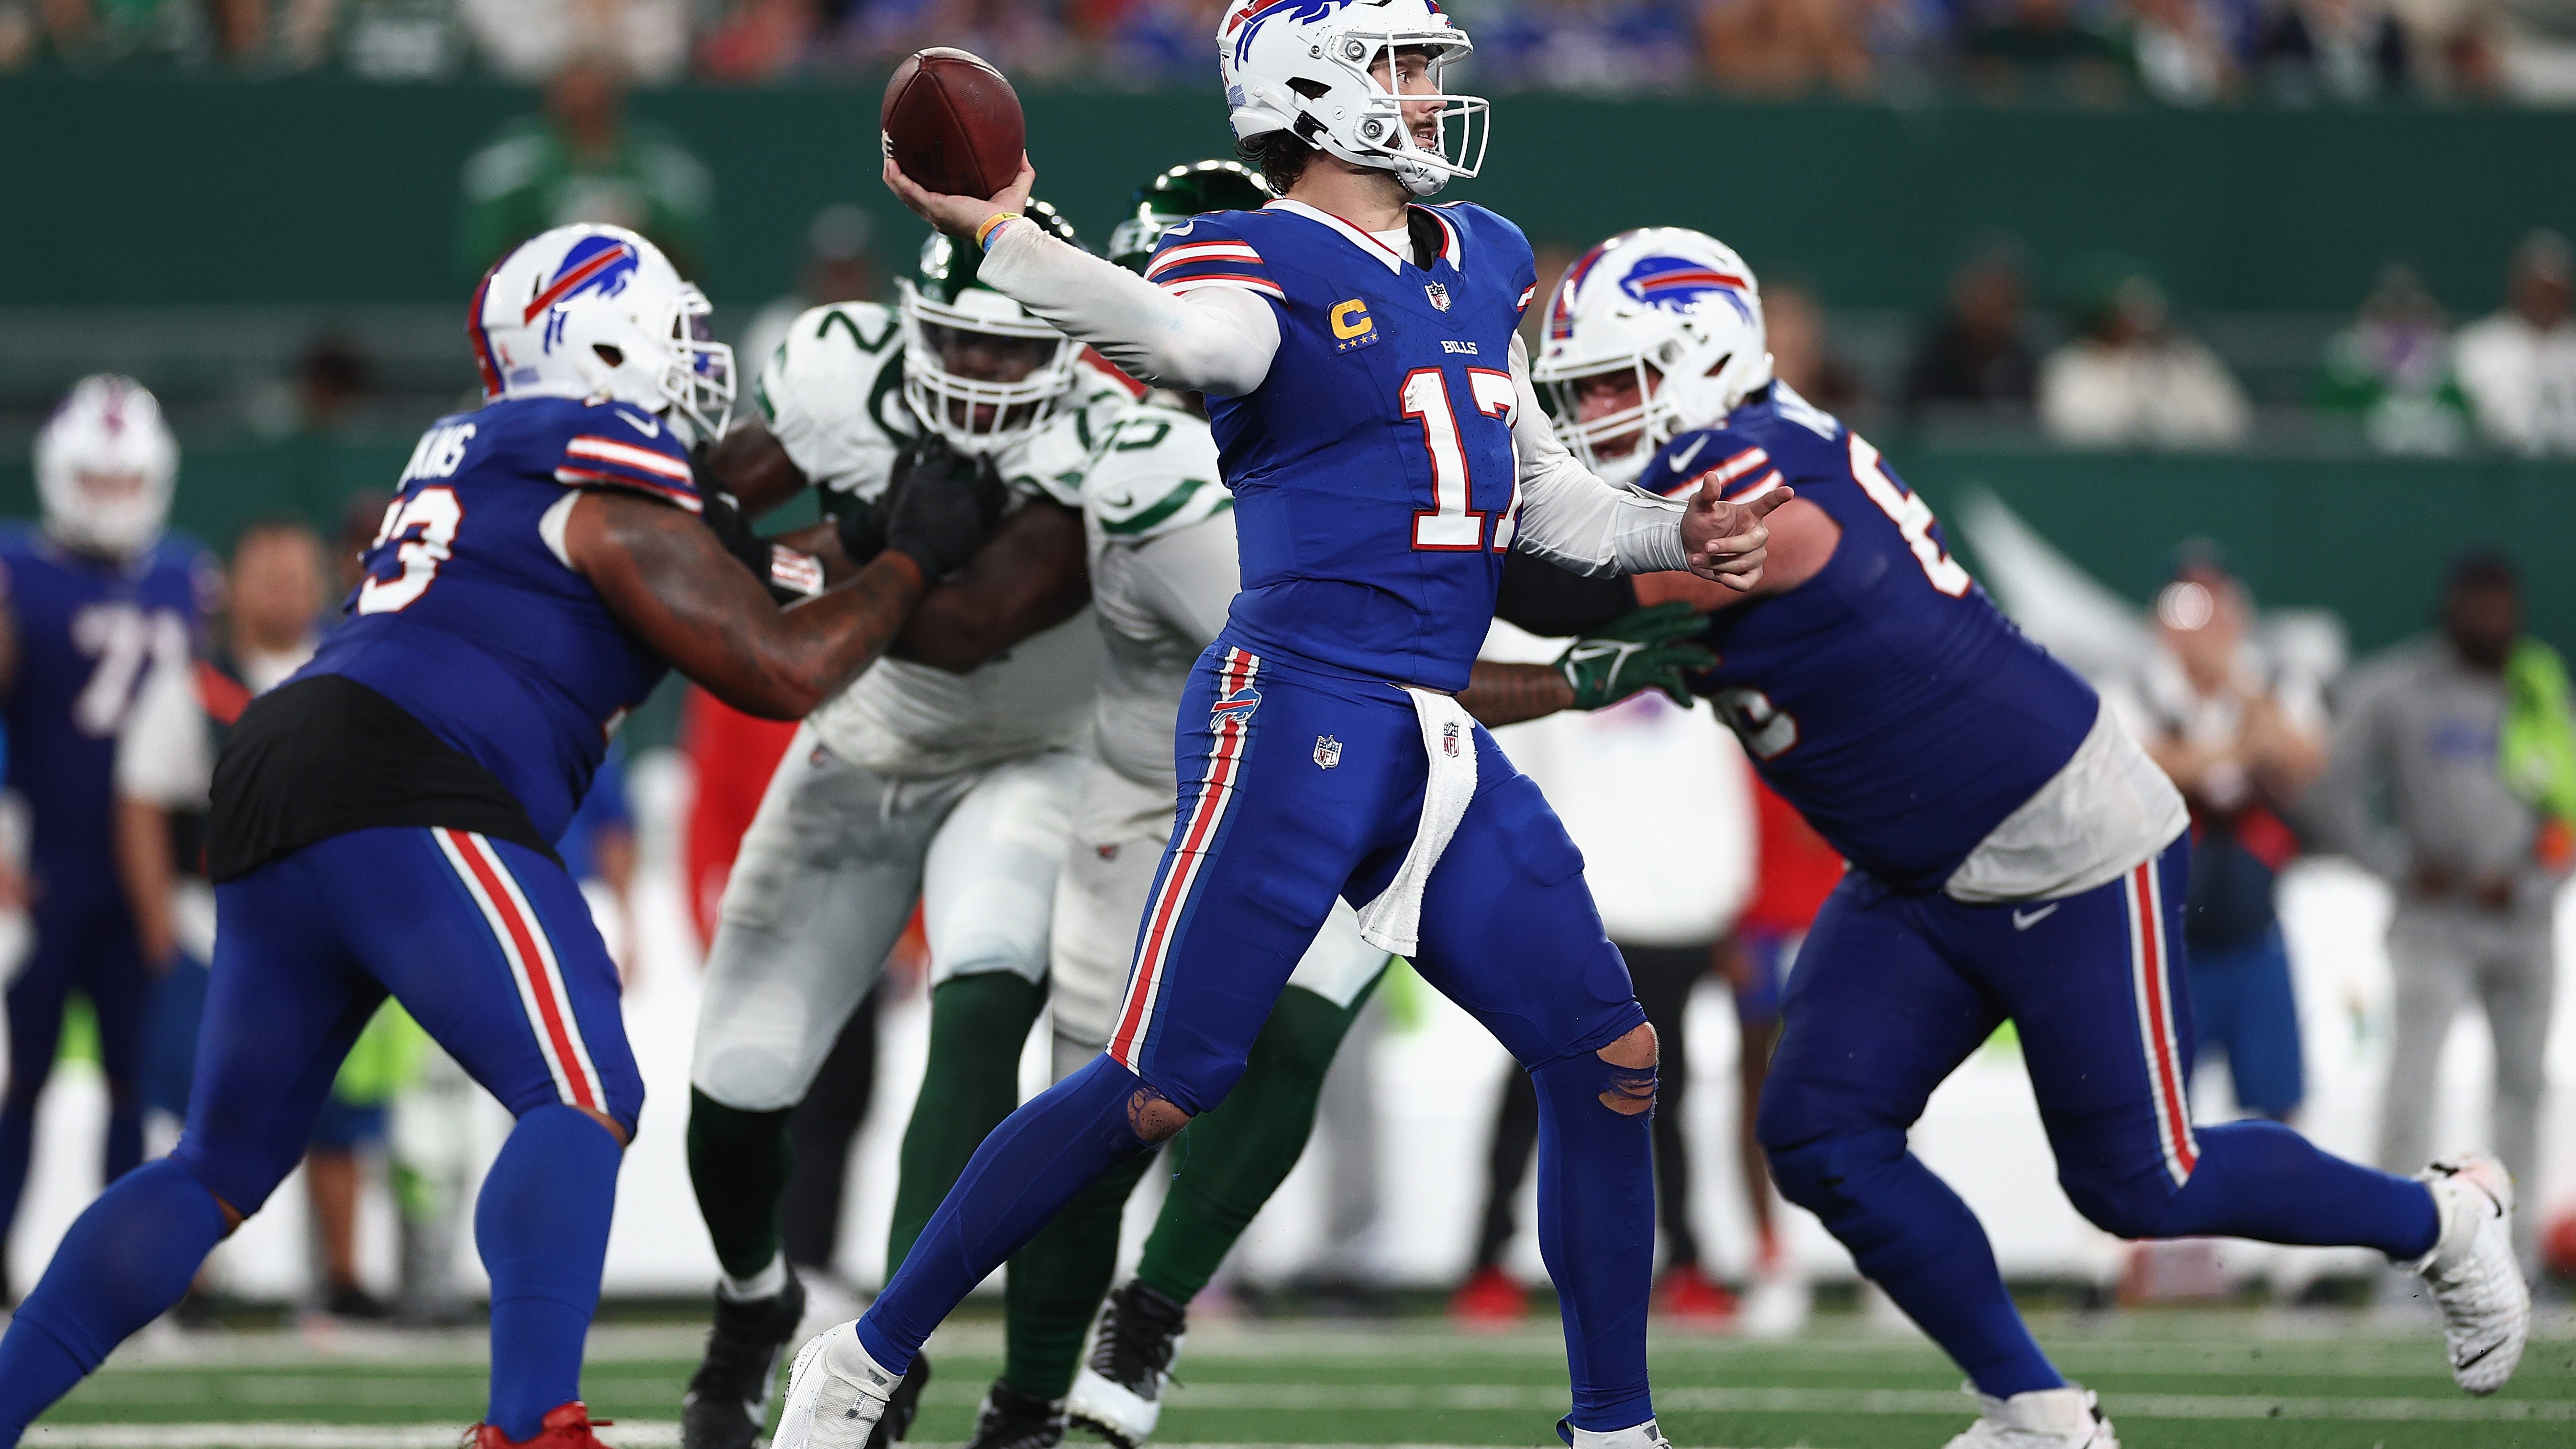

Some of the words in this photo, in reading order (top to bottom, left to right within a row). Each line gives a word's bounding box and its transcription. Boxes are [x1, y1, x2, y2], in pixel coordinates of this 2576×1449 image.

[1330, 299, 1373, 340] C
[1440, 340, 1479, 355] BILLS
[1399, 365, 1524, 555] 17
[1317, 749, 1335, 763] NFL
[1443, 737, 1458, 756] NFL
